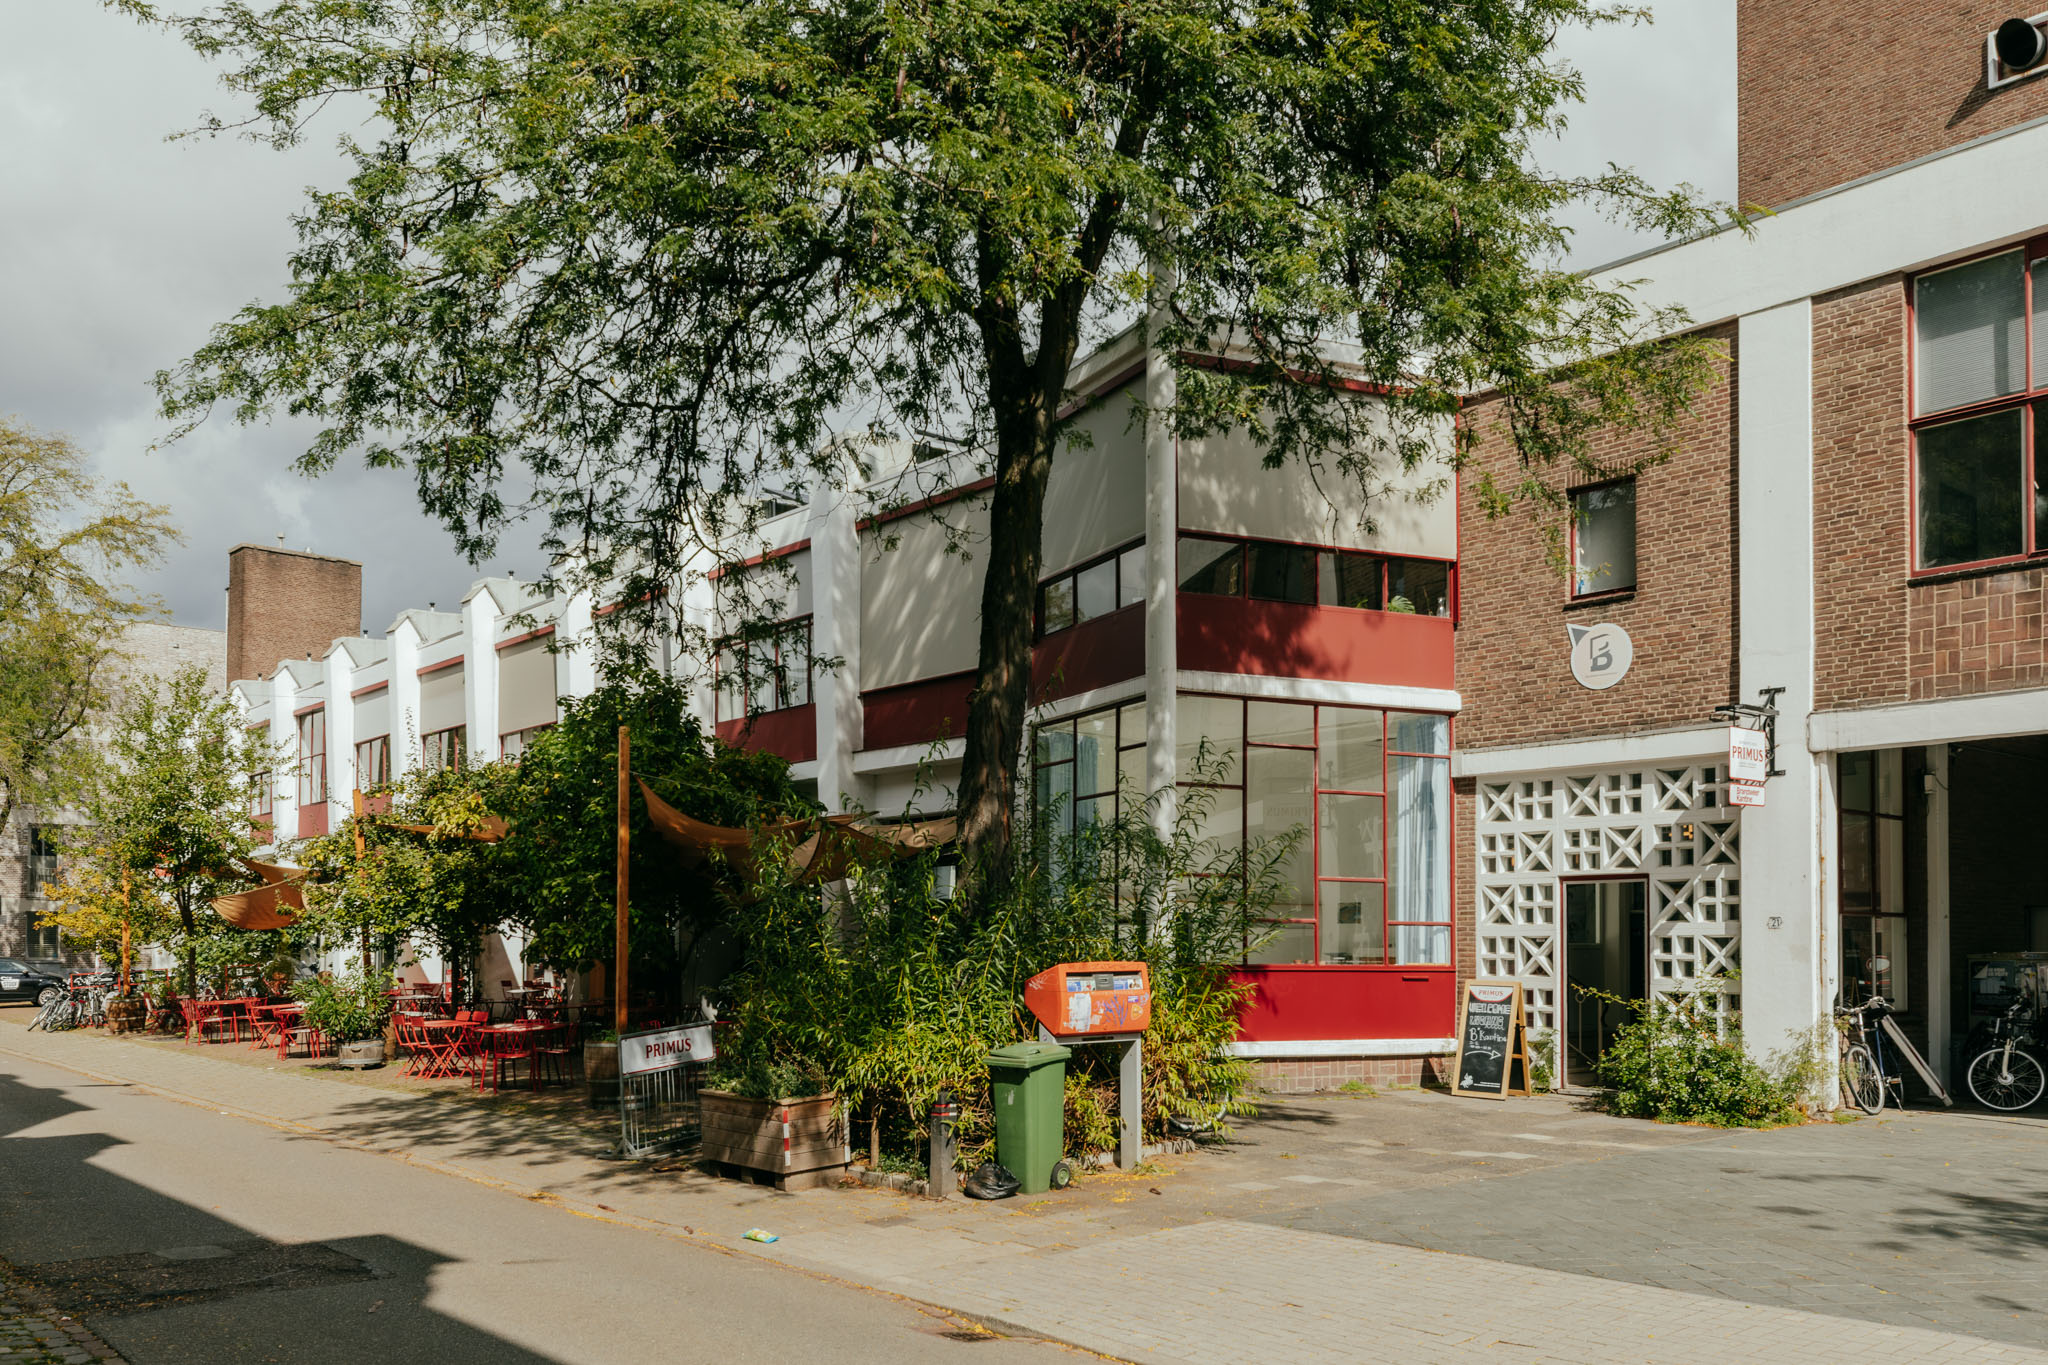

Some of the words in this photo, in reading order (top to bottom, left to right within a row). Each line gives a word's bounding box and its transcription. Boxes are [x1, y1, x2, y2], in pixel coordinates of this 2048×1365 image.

[1732, 746, 1764, 762] PRIMUS
[1478, 989, 1504, 997] PRIMUS
[1468, 1002, 1511, 1015] WELCOME
[645, 1038, 692, 1059] PRIMUS
